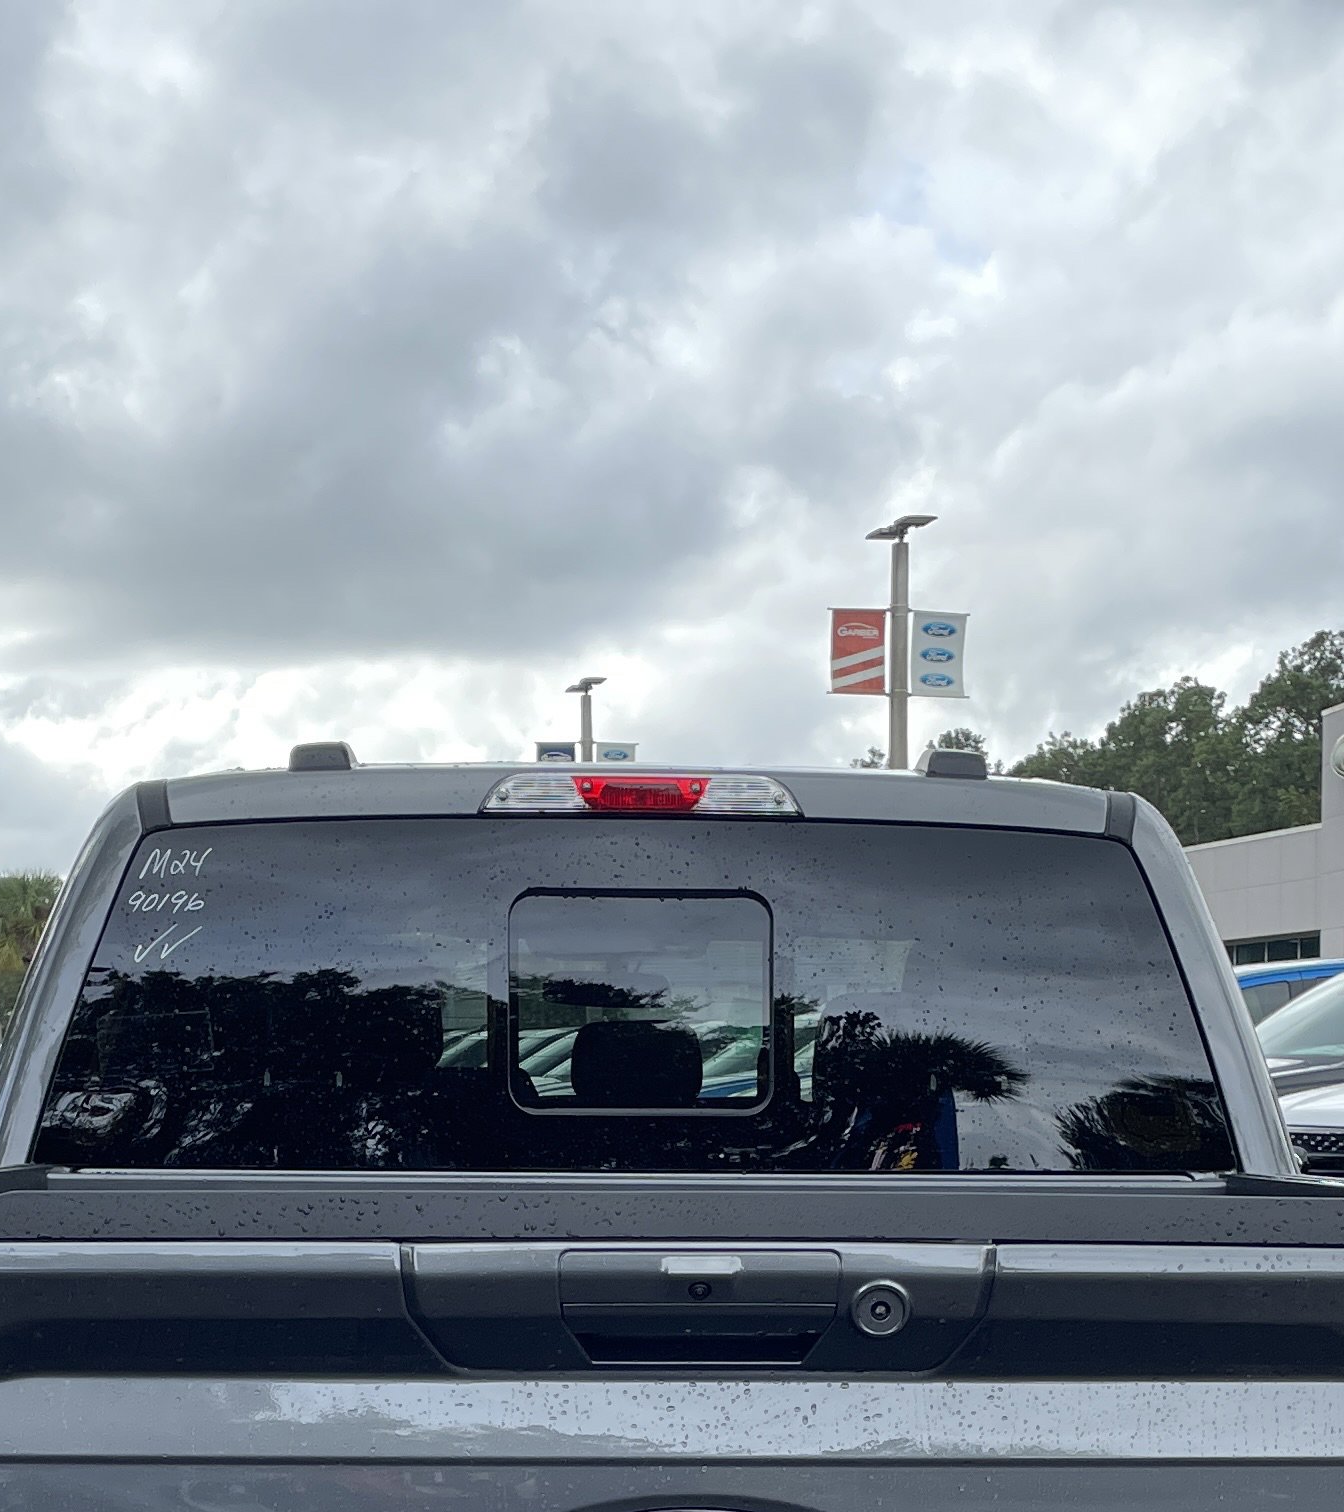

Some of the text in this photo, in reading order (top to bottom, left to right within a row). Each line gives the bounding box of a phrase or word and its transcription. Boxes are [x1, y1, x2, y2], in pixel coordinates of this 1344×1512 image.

[837, 625, 879, 637] GARBER
[927, 623, 951, 637] Ford
[139, 847, 213, 880] M24
[128, 890, 205, 914] 90196
